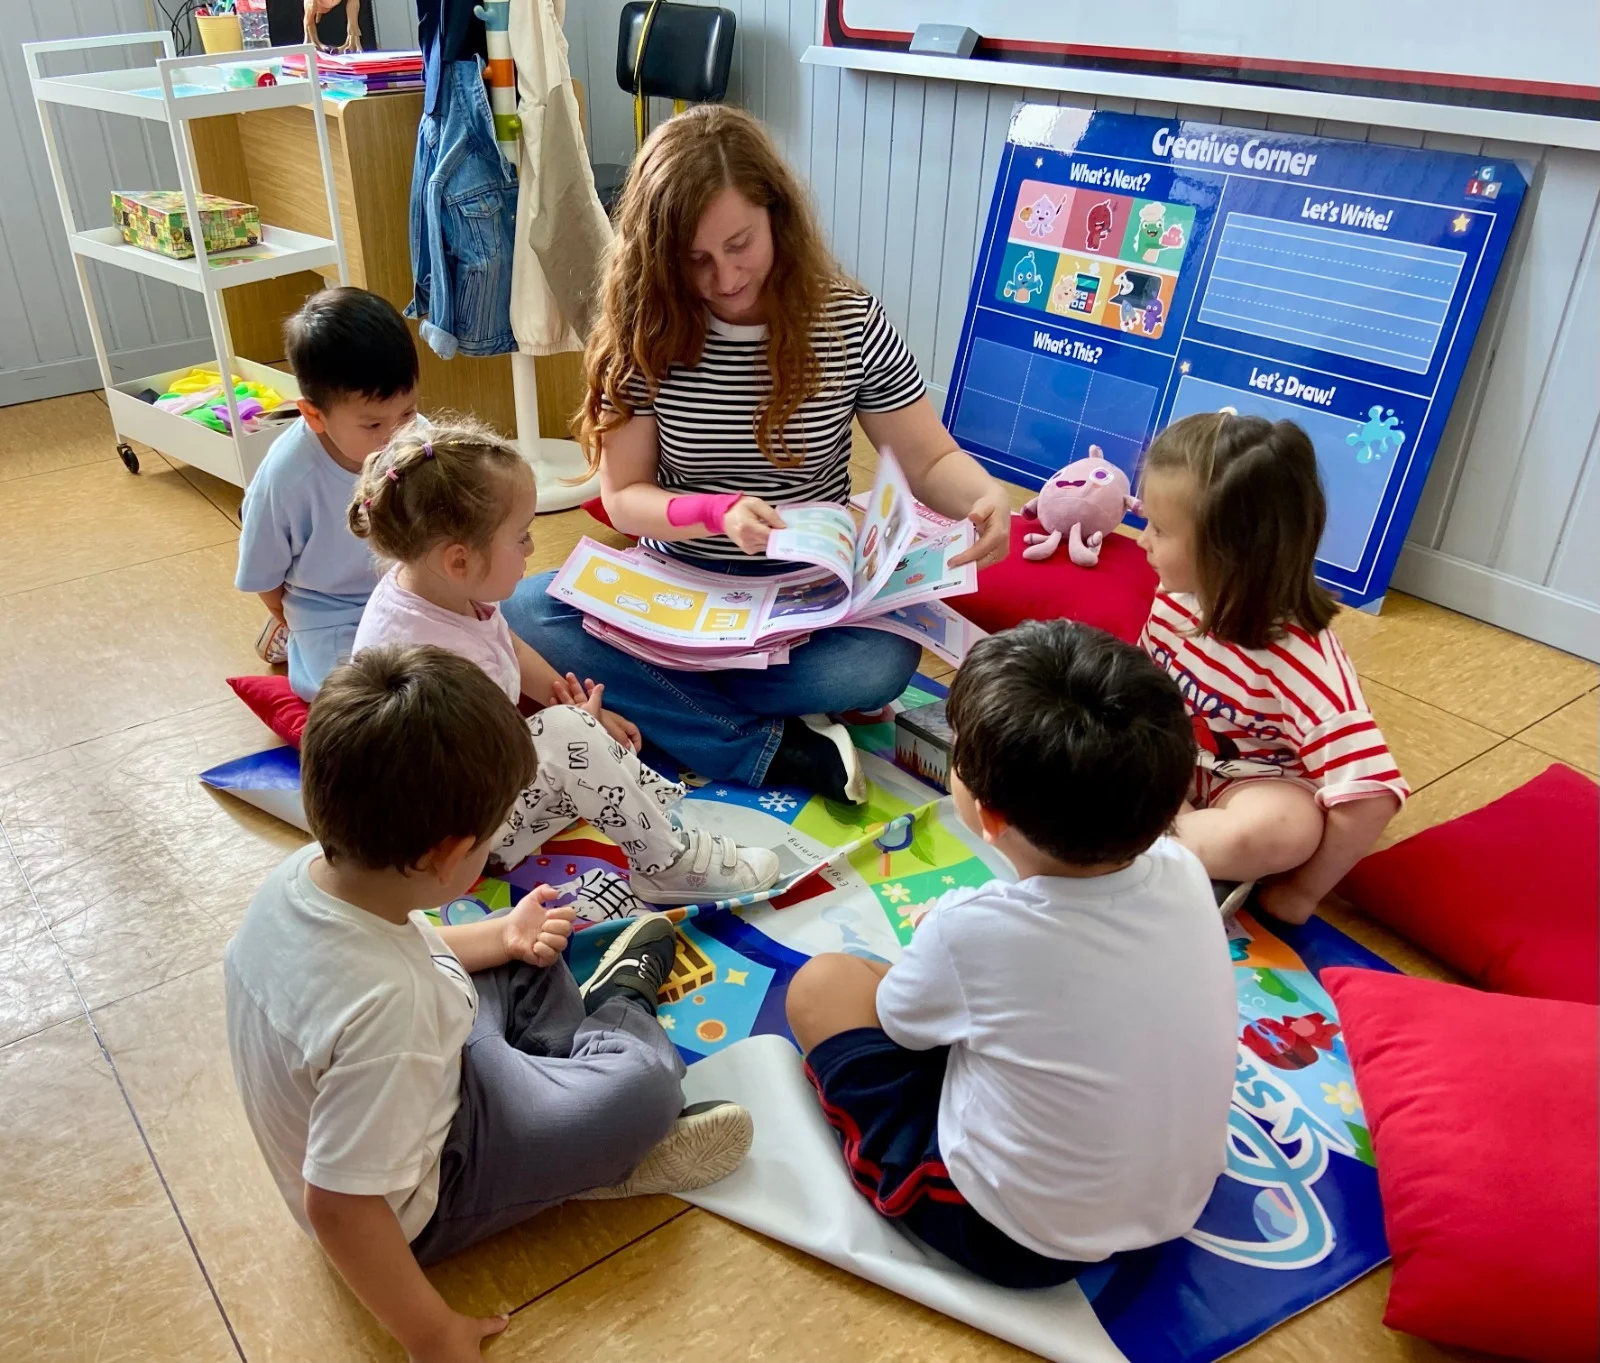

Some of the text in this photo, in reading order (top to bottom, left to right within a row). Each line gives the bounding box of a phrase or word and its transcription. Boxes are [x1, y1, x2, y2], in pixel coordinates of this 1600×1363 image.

[1152, 127, 1318, 176] Creative Corner
[1070, 162, 1151, 192] What's Next?
[1301, 197, 1394, 232] Let's Write!
[1033, 330, 1103, 365] What's This?
[1248, 367, 1337, 406] Let's Draw!
